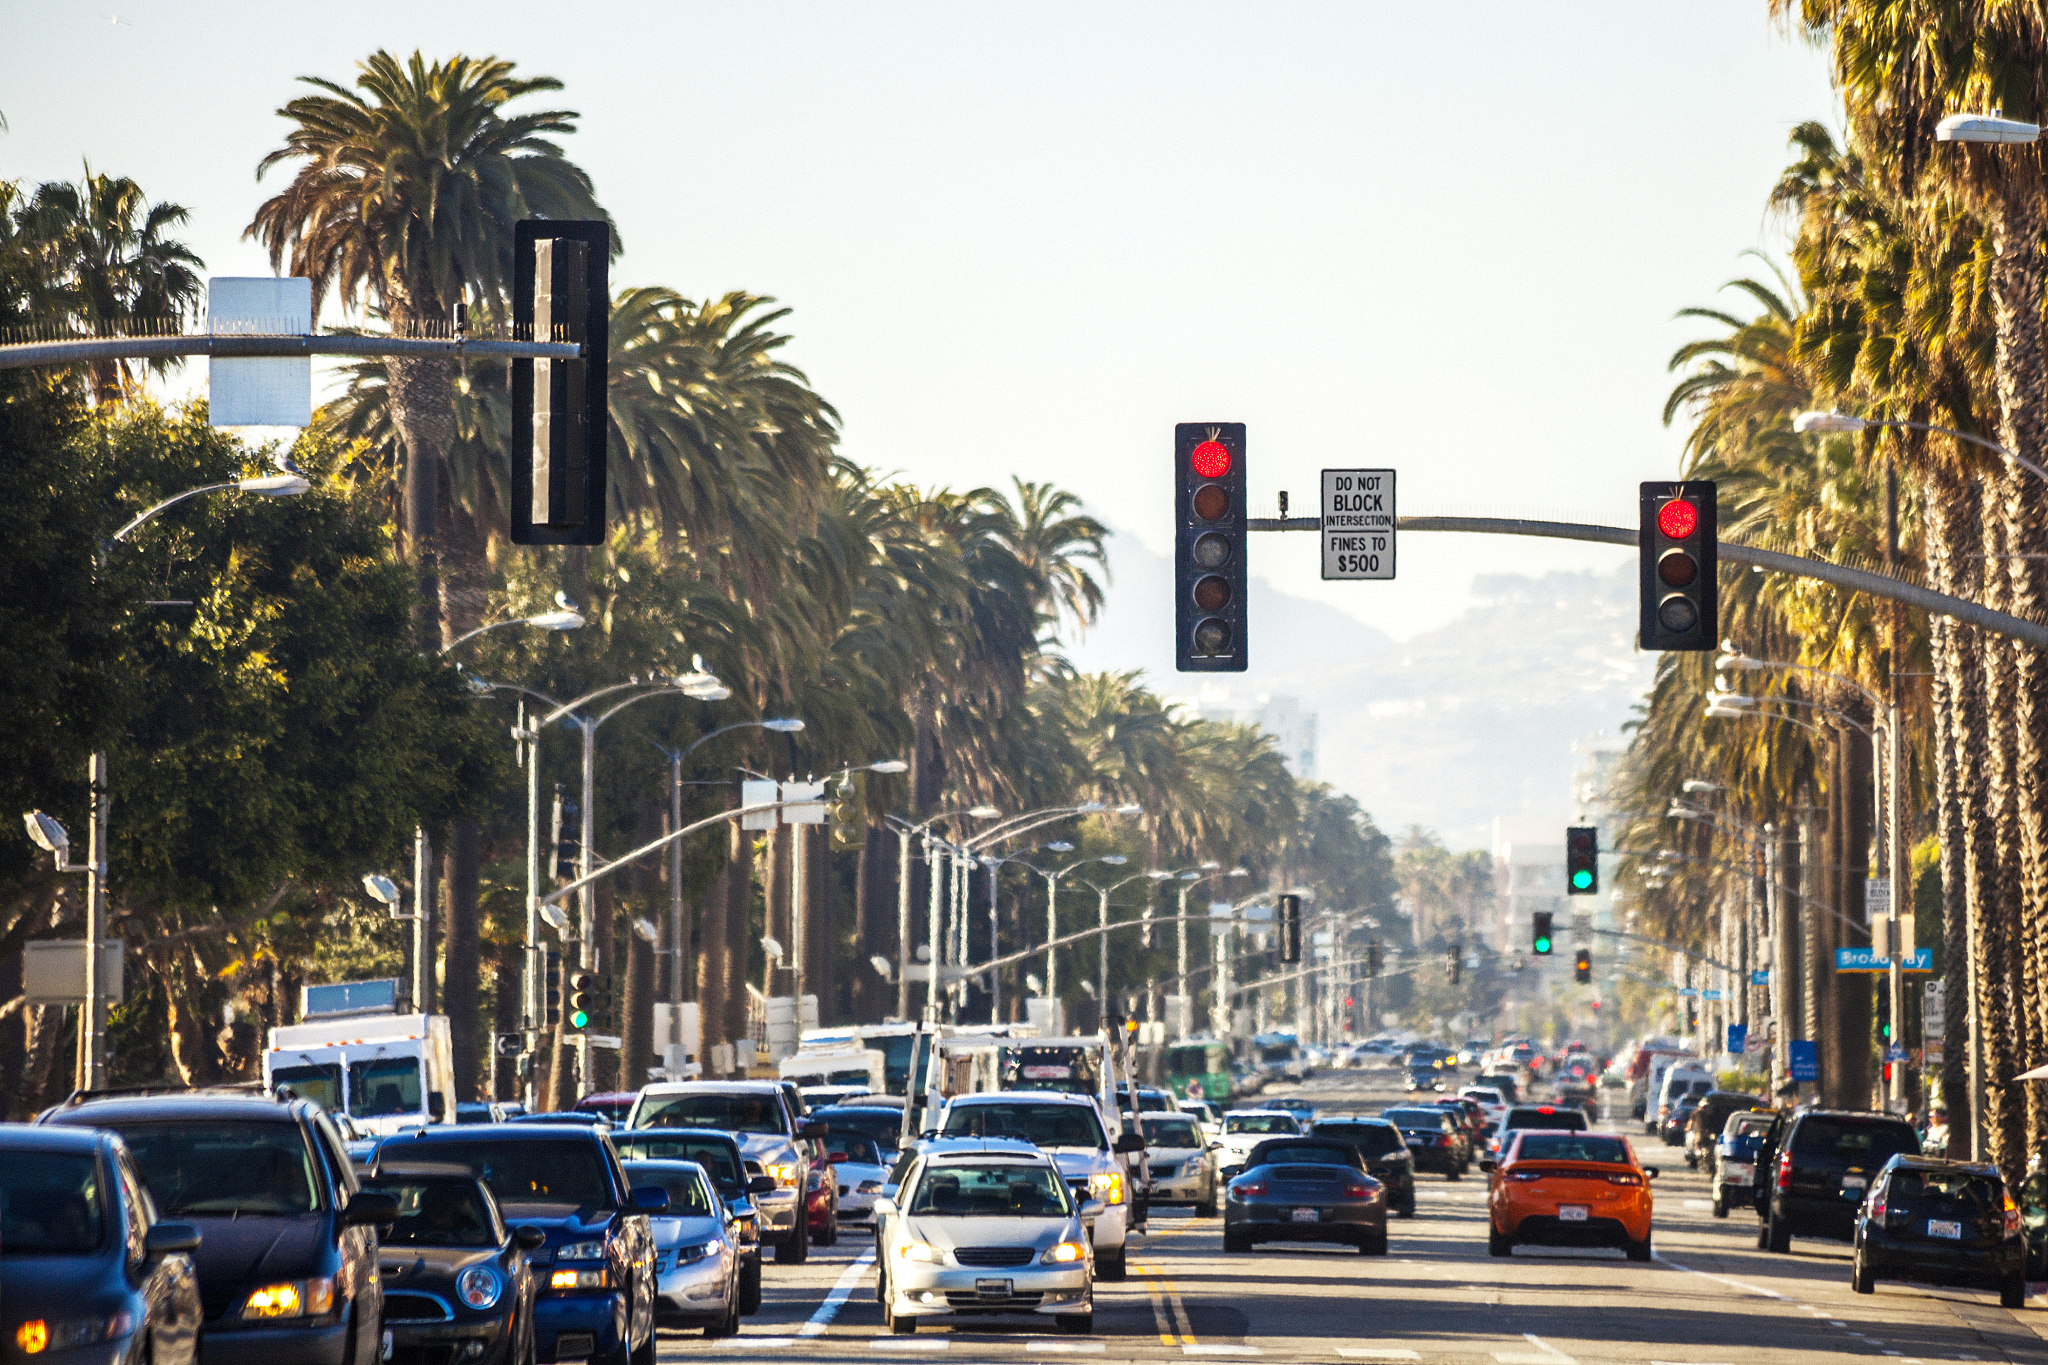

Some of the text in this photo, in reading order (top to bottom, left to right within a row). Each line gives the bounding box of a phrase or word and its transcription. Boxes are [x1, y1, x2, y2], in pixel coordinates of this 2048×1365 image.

[1336, 477, 1381, 491] DO NOT
[1334, 495, 1383, 512] BLOCK
[1326, 515, 1391, 526] INTERSECTION
[1331, 537, 1386, 551] FINES TO
[1338, 554, 1379, 572] $500
[1841, 951, 1926, 968] Broaday
